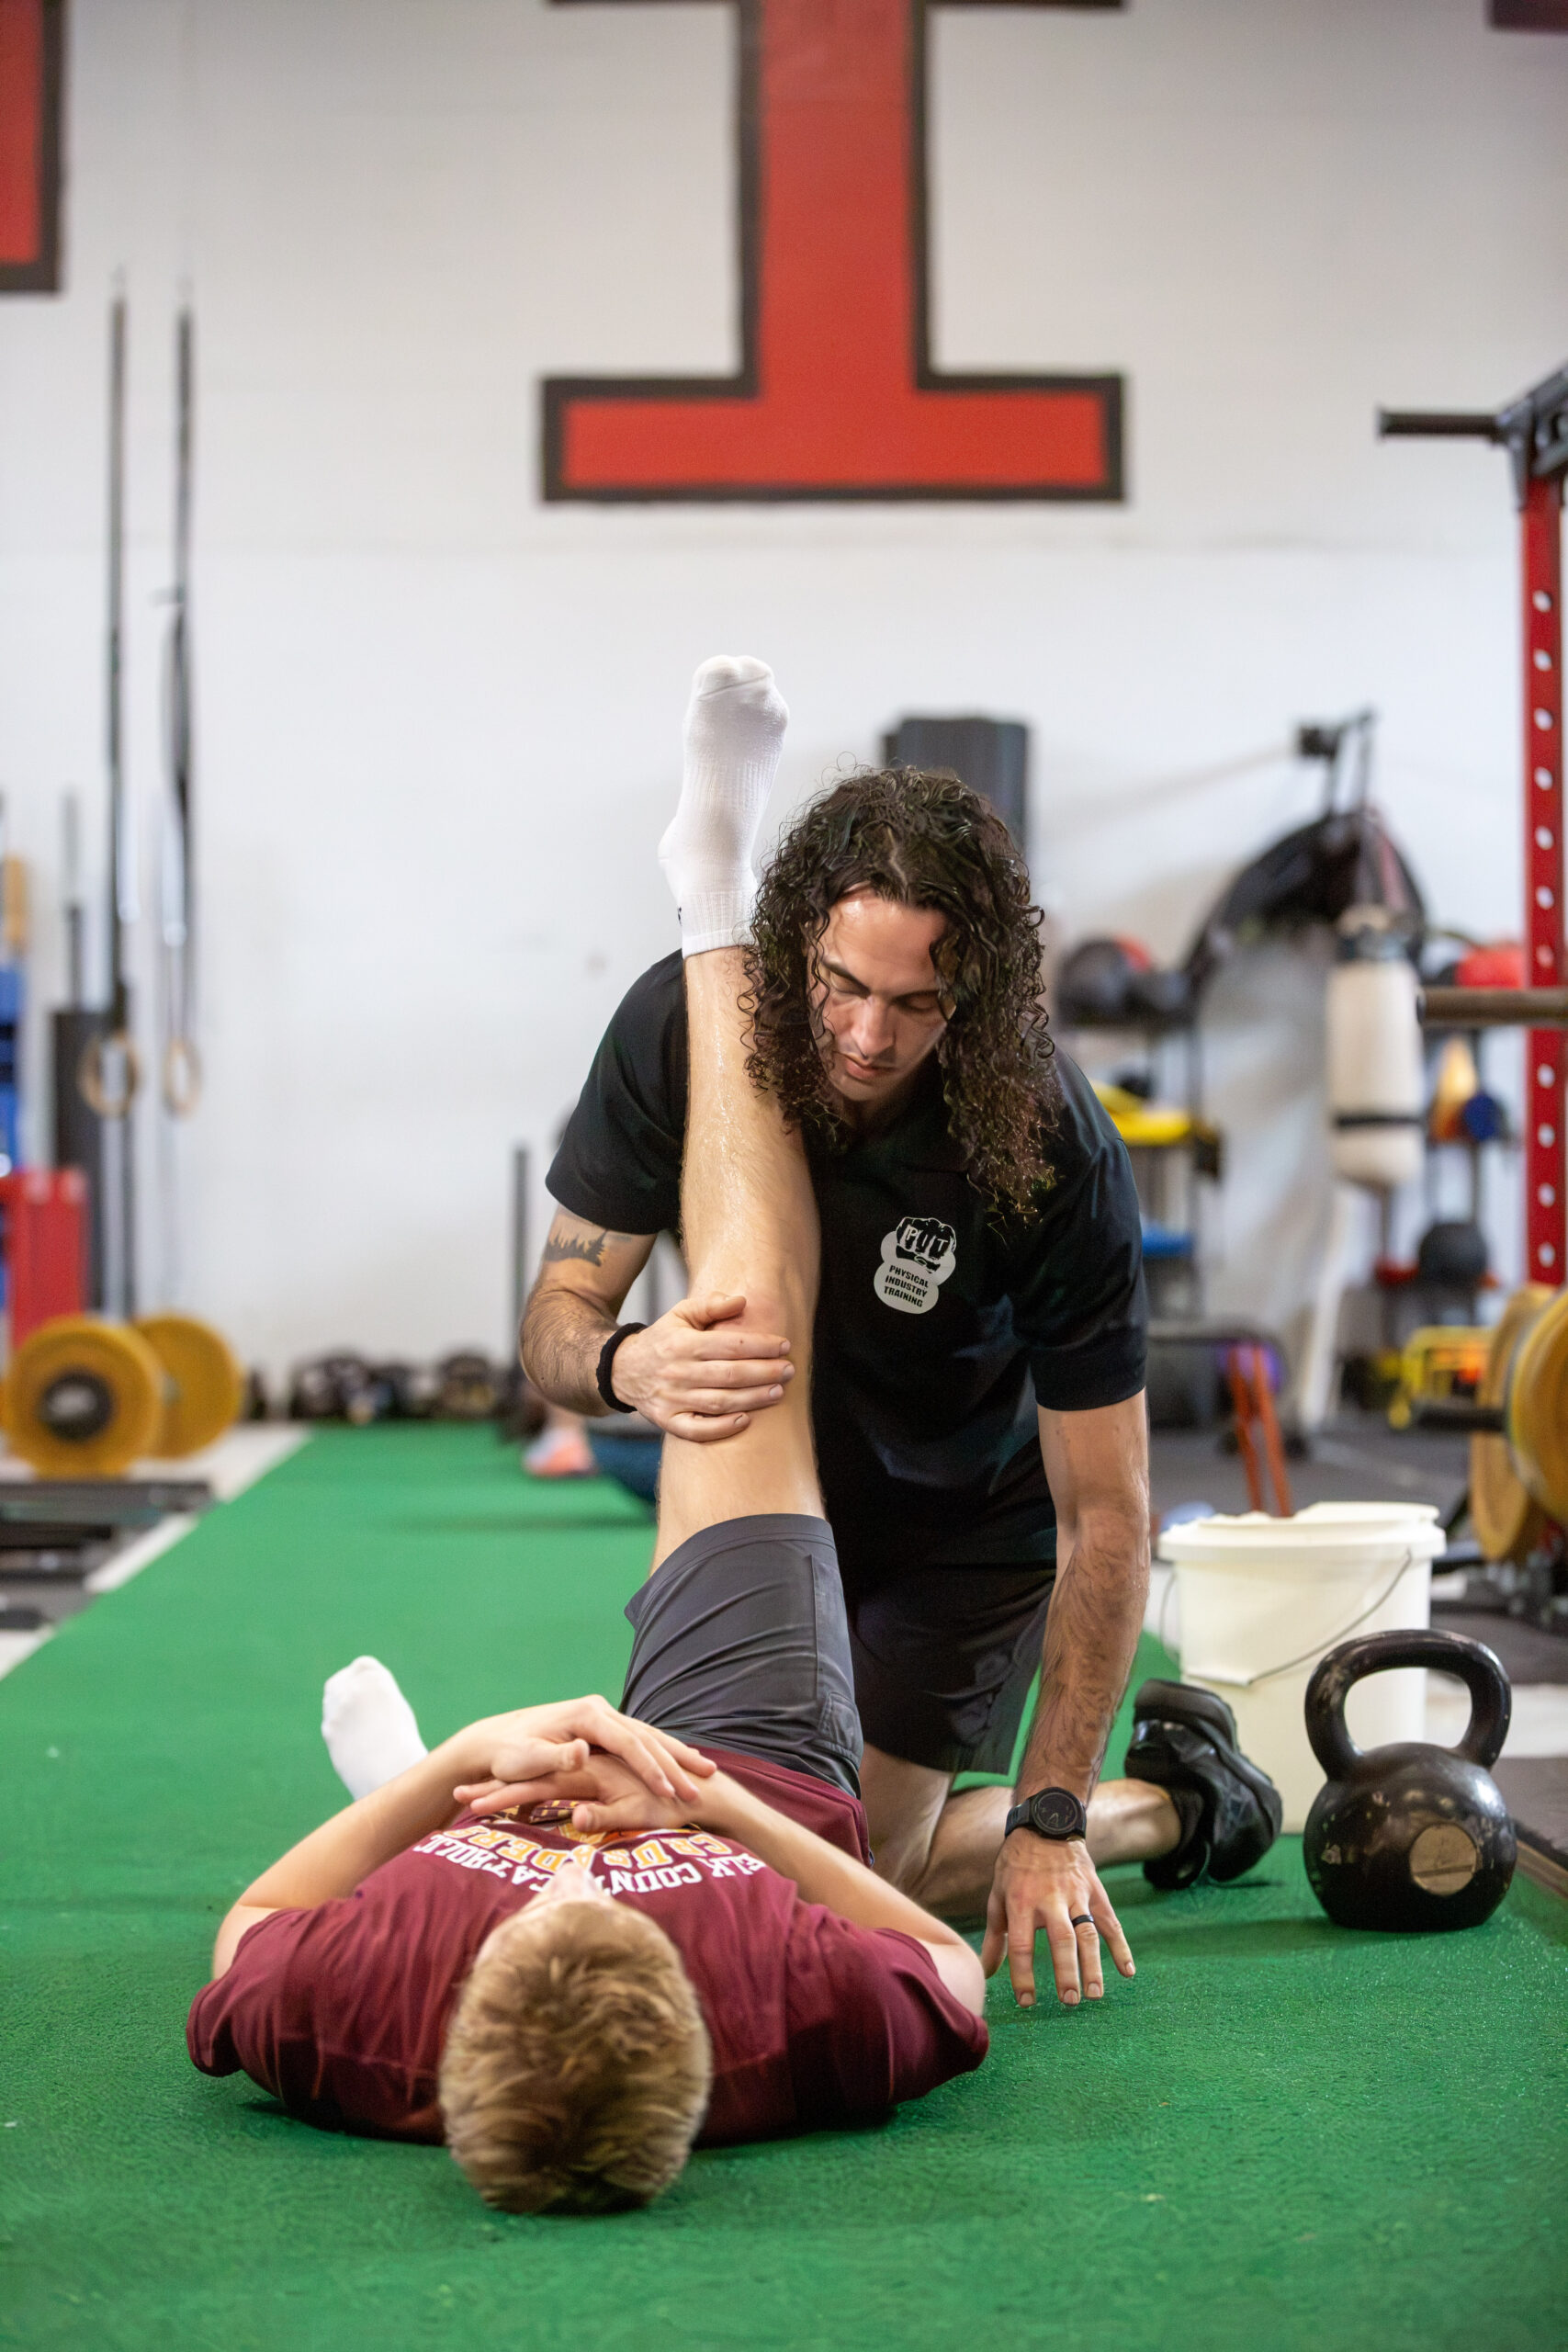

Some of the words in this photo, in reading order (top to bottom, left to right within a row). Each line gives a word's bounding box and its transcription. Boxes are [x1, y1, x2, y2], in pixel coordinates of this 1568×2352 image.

[885, 1274, 928, 1297] INDUSTRY
[888, 1264, 930, 1288] PHYSICAL
[884, 1285, 923, 1307] TRAINING
[443, 1825, 733, 1875] CRUSADERS
[696, 1852, 767, 1877] ELK
[594, 1862, 703, 1895] COUNT
